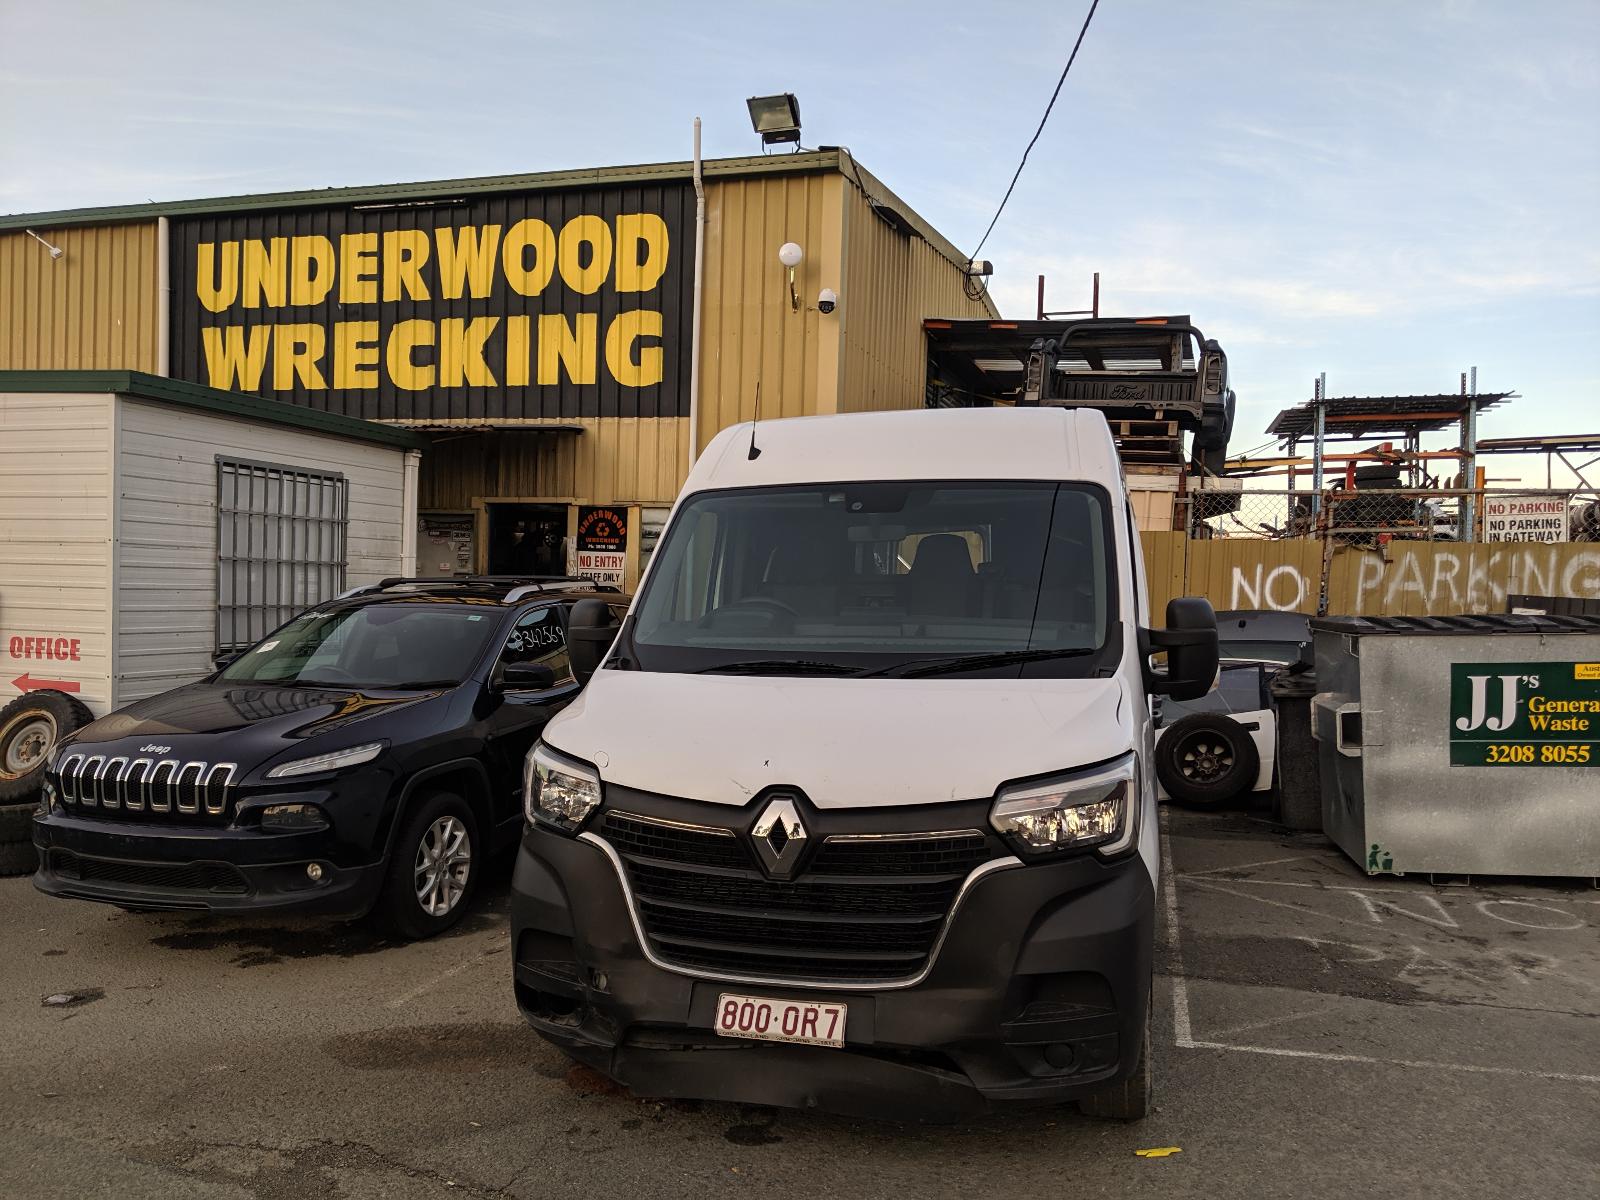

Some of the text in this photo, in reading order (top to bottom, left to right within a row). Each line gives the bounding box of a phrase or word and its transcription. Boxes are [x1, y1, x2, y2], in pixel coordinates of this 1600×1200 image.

[196, 213, 670, 313] UNDERWOOD
[202, 309, 664, 391] WRECKING
[1110, 384, 1146, 400] Ford
[1488, 501, 1564, 515] NO PARKING
[579, 509, 626, 536] UNDERWOOD
[1489, 518, 1561, 531] NO PARKING
[1489, 531, 1562, 542] IN GATEWAY
[579, 555, 624, 568] NO ENTRY
[603, 572, 620, 583] ONLY
[1231, 550, 1600, 614] NO PARKING
[9, 636, 81, 661] OFFICE
[1528, 714, 1590, 731] Waste
[139, 743, 172, 755] Jeep
[1485, 745, 1591, 763] 3208 8055
